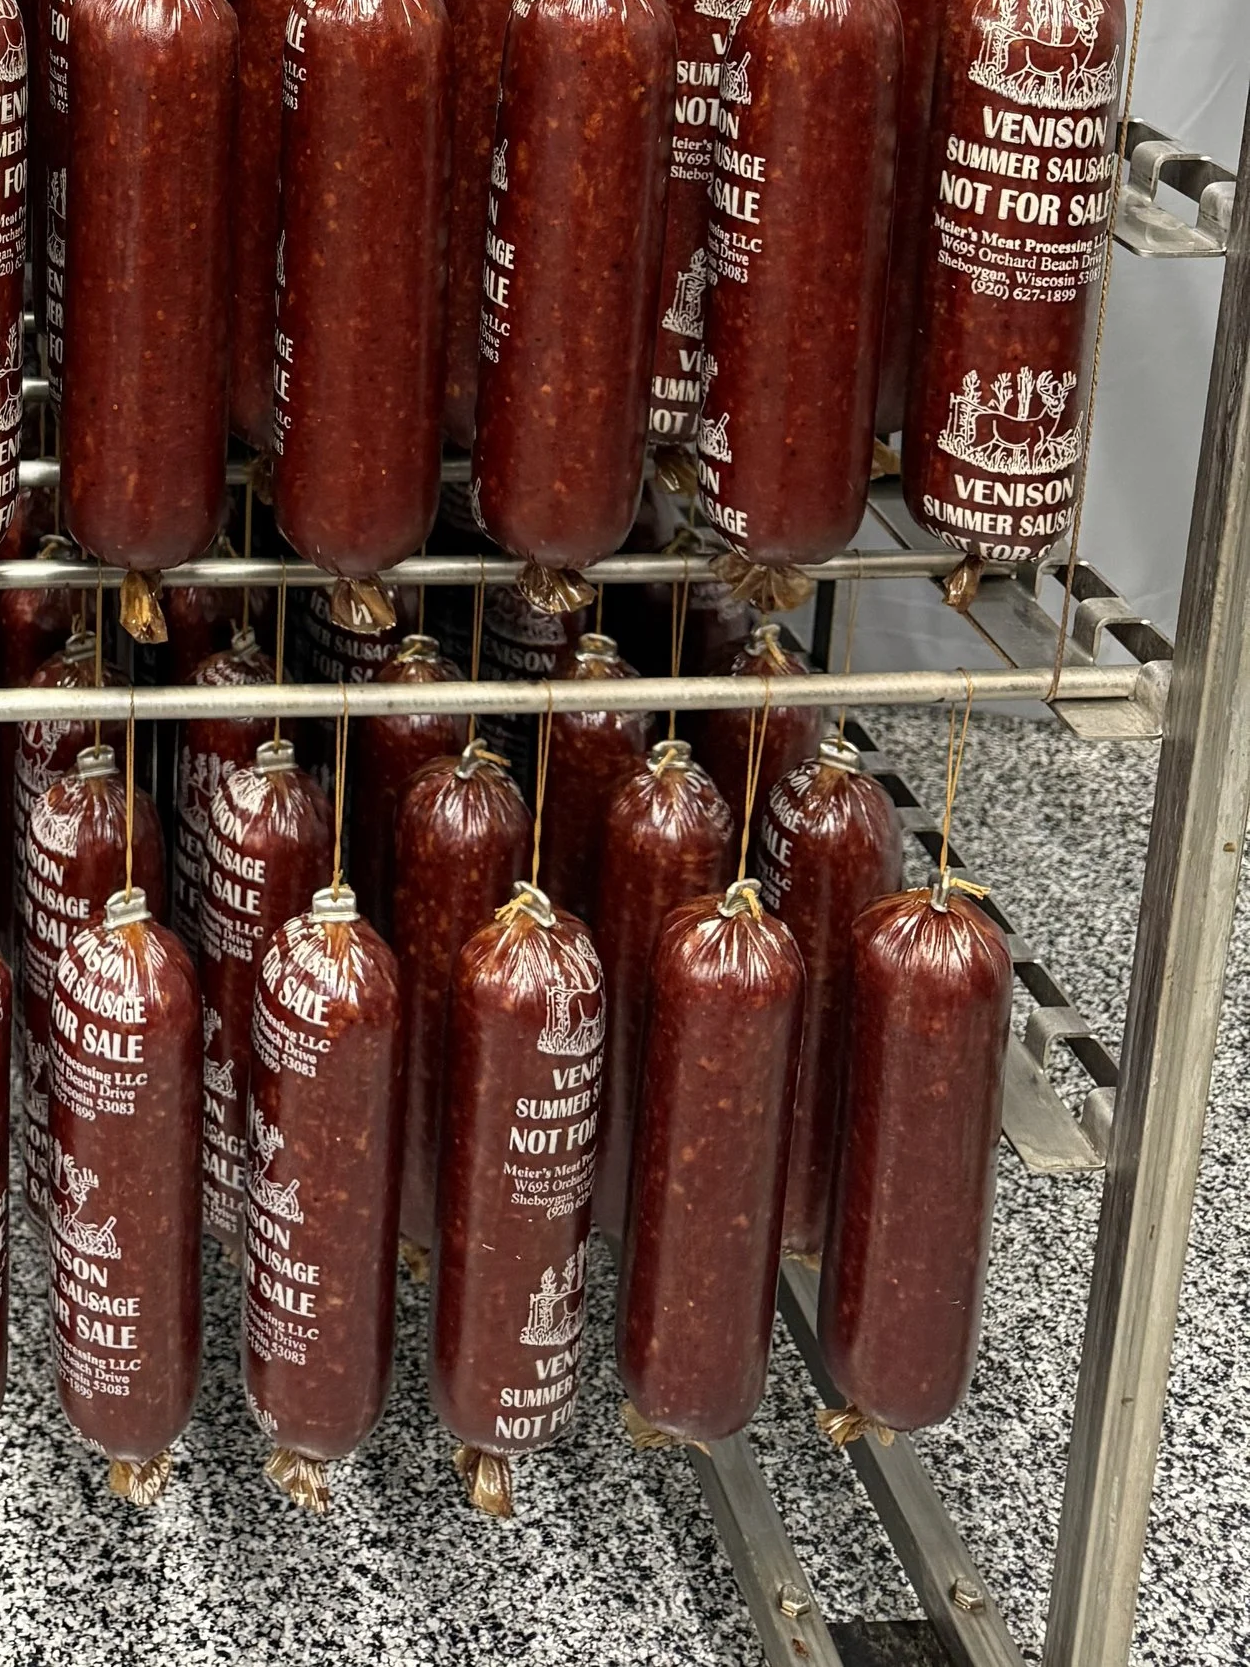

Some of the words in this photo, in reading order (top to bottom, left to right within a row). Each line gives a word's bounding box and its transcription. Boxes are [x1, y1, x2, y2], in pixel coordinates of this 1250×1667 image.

[982, 105, 1108, 150] VENISON
[673, 150, 711, 167] W695
[946, 134, 1040, 181] SUMMER
[713, 176, 761, 225] SALE
[939, 170, 993, 215] NOT
[998, 189, 1061, 226] FOR
[732, 231, 763, 254] LLC
[981, 230, 1022, 251] Meat
[720, 245, 750, 267] Drive
[978, 247, 1037, 269] Orchard
[1041, 256, 1079, 272] Beach
[1012, 288, 1077, 302] 627-1899
[954, 474, 1075, 507] VENISON
[923, 495, 1013, 535] SUMMER
[212, 871, 262, 916] SALE
[73, 977, 147, 1024] SAUSAGE
[278, 975, 331, 1027] SALE
[82, 1023, 144, 1063] SALE
[284, 1042, 317, 1064] Drive
[298, 1032, 331, 1053] LLC
[114, 1072, 148, 1086] LLC
[100, 1085, 136, 1101] Drive
[515, 1089, 591, 1120] SUMMER
[96, 1099, 135, 1116] 53083
[508, 1126, 563, 1154] NOT
[503, 1162, 551, 1179] Meier's
[554, 1162, 580, 1178] Meat
[514, 1179, 550, 1194] W695
[59, 1272, 141, 1317] SAUSAGE
[259, 1272, 317, 1318] SALE
[76, 1314, 138, 1350] SALE
[288, 1322, 320, 1341] LLC
[95, 1368, 130, 1385] Drive
[109, 1359, 142, 1372] LLC
[499, 1374, 574, 1408] SUMMER
[495, 1414, 547, 1440] NOT
